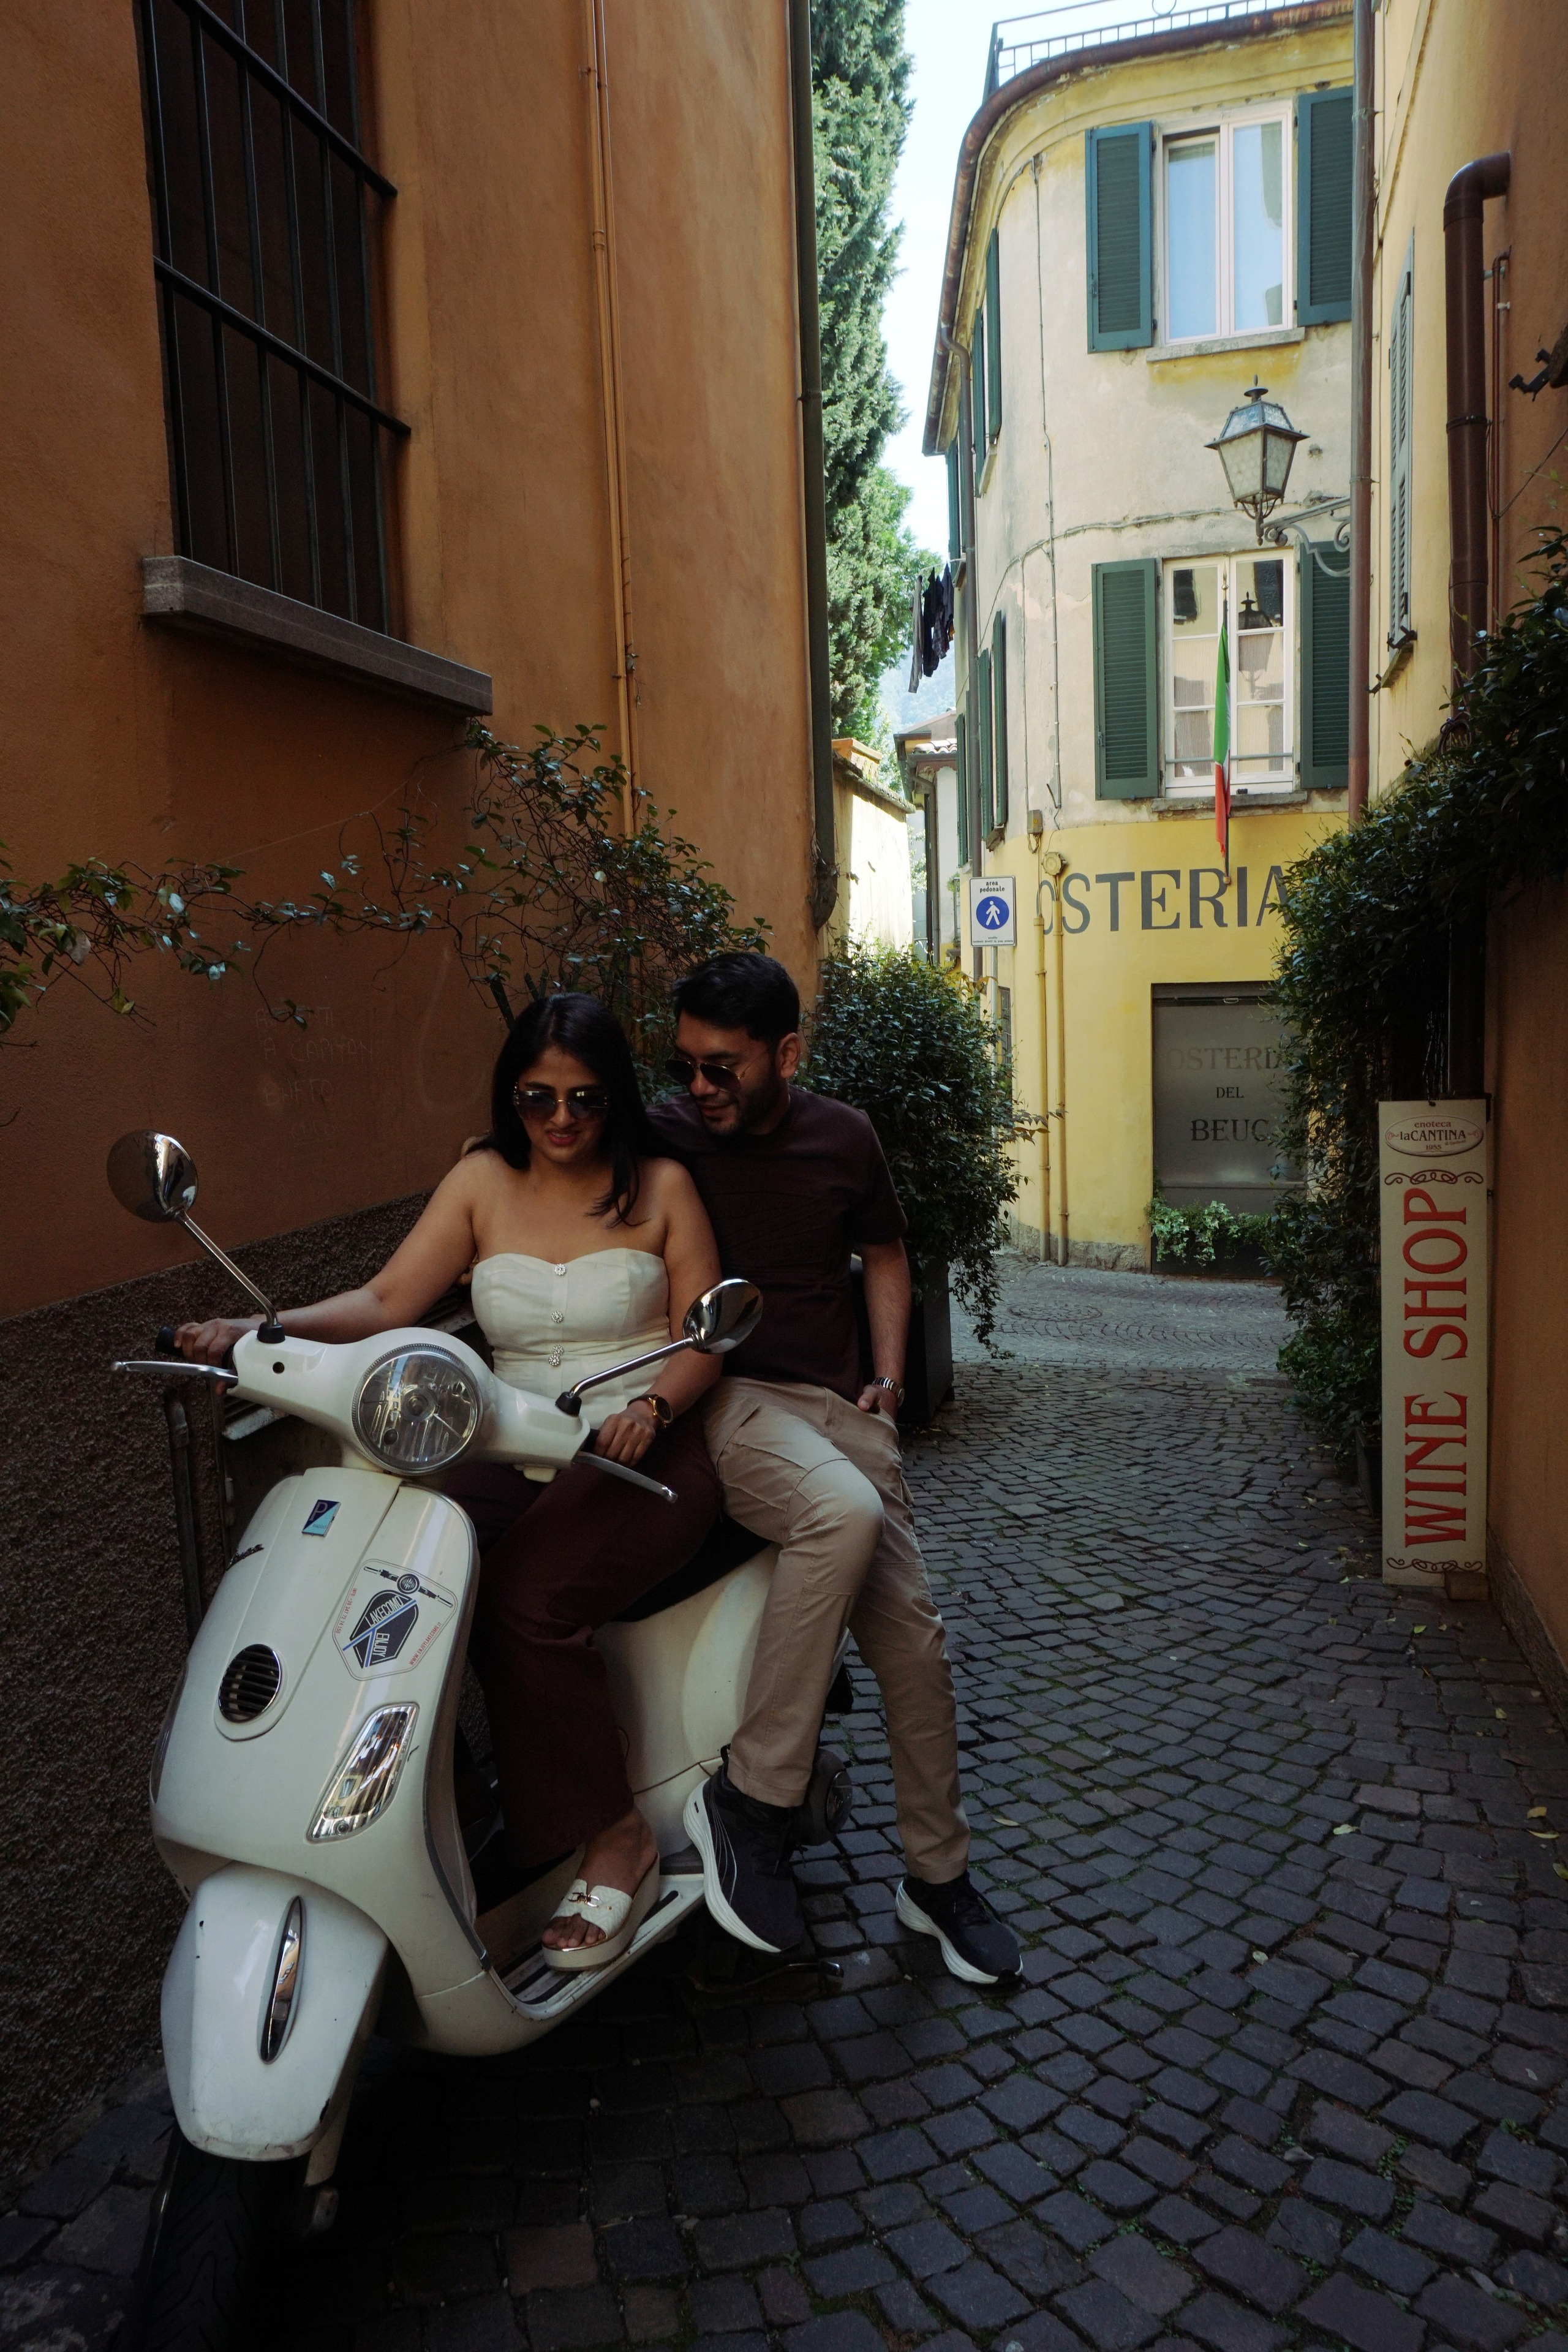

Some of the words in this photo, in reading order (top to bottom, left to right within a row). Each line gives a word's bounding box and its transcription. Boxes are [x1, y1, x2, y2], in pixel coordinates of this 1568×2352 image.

[1216, 1087, 1245, 1098] DEL
[1400, 1129, 1466, 1141] laCANTINA
[1403, 1187, 1468, 1361] SHOP
[1404, 1391, 1468, 1548] WINE
[364, 1595, 404, 1627] LAKECOMO
[372, 1632, 390, 1658] ENJOY
